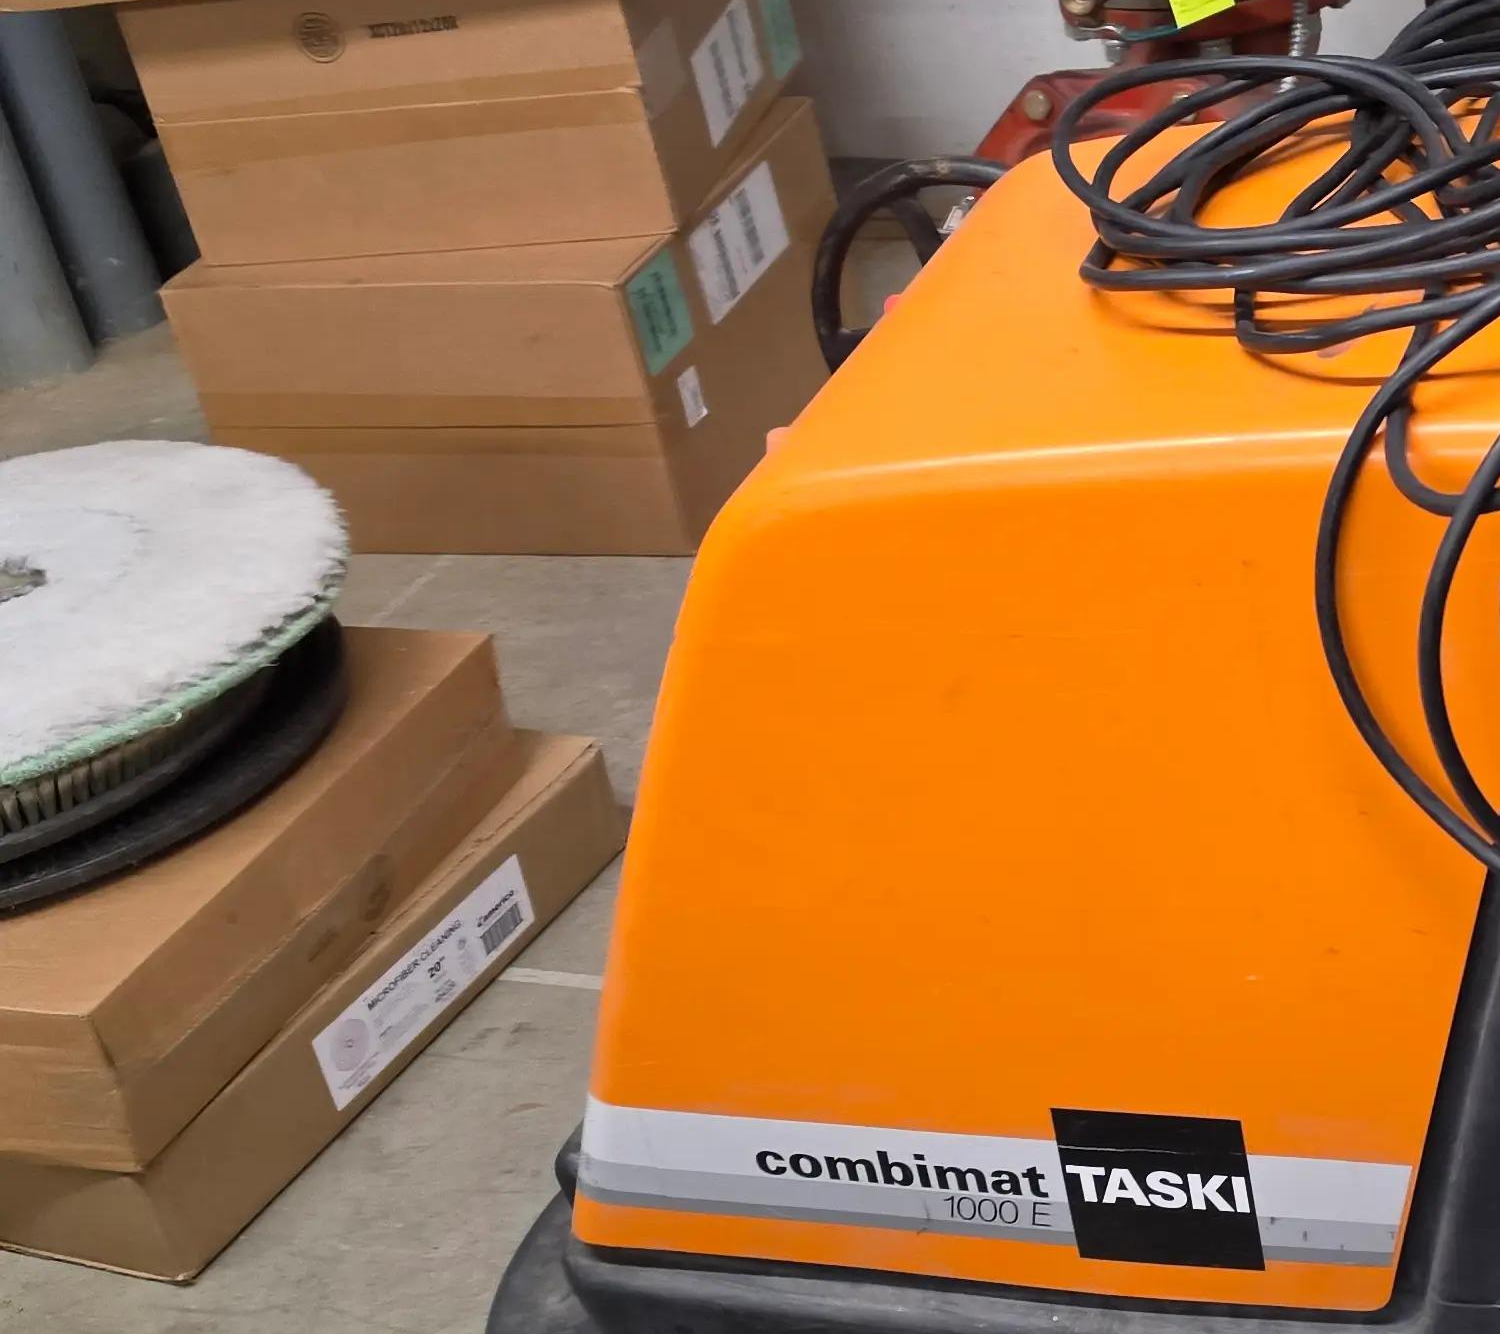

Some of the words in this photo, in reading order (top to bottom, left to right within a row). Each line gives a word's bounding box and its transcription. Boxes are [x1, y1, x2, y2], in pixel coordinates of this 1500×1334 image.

[367, 958, 420, 1011] MICROFIBER
[420, 918, 462, 962] CLEANING
[755, 1150, 1049, 1198] combimat
[1065, 1164, 1251, 1213] TASKI
[943, 1195, 1020, 1224] 1000
[1031, 1201, 1053, 1228] E
